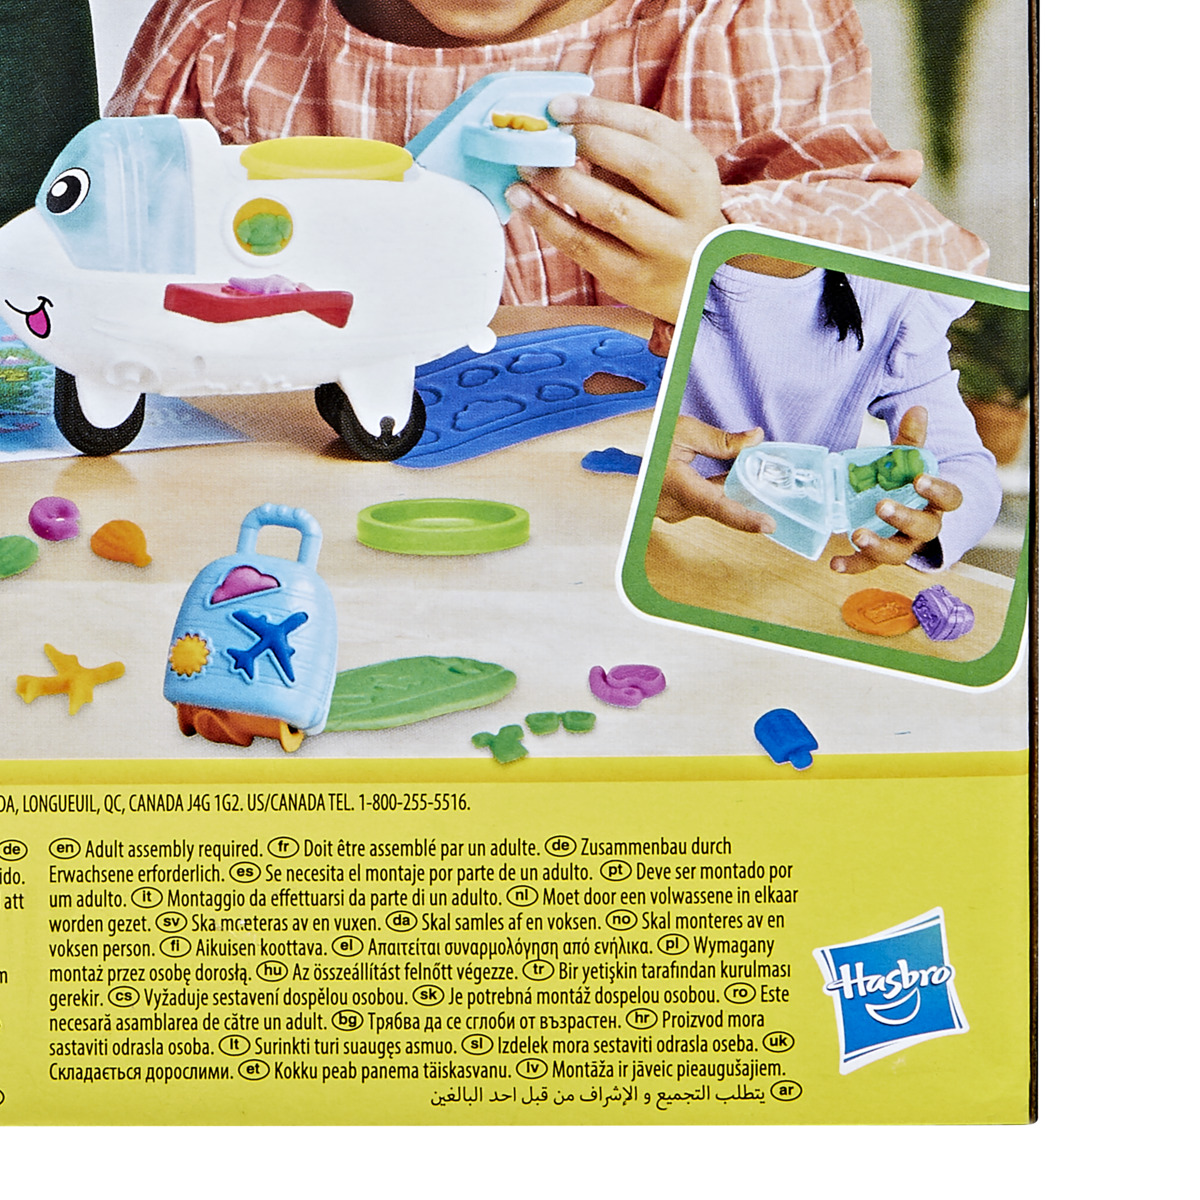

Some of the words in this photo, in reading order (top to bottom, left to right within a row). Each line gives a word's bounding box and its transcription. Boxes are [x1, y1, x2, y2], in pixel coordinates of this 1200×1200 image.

[23, 794, 100, 815] LONGUEUIL,
[104, 794, 125, 815] QC,
[129, 794, 184, 812] CANADA
[187, 794, 210, 812] J4G
[215, 793, 243, 811] 1G2.
[248, 793, 325, 812] US/CANADA
[328, 793, 354, 811] TEL.
[359, 793, 470, 811] 1-800-255-5516.
[3, 843, 20, 855] de
[56, 844, 74, 853] en
[85, 840, 124, 858] Adult
[128, 839, 194, 862] assembly
[199, 839, 263, 862] required.
[278, 840, 289, 852] fr
[304, 839, 333, 857] Doit
[337, 839, 365, 857] être
[370, 838, 436, 857] assemblé
[441, 843, 464, 861] par
[468, 843, 485, 856] un
[490, 838, 540, 856] adulte.
[552, 839, 569, 851] de
[581, 837, 686, 856] Zusammenbau
[691, 836, 731, 855] durch
[826, 959, 955, 1000] Hasbro
